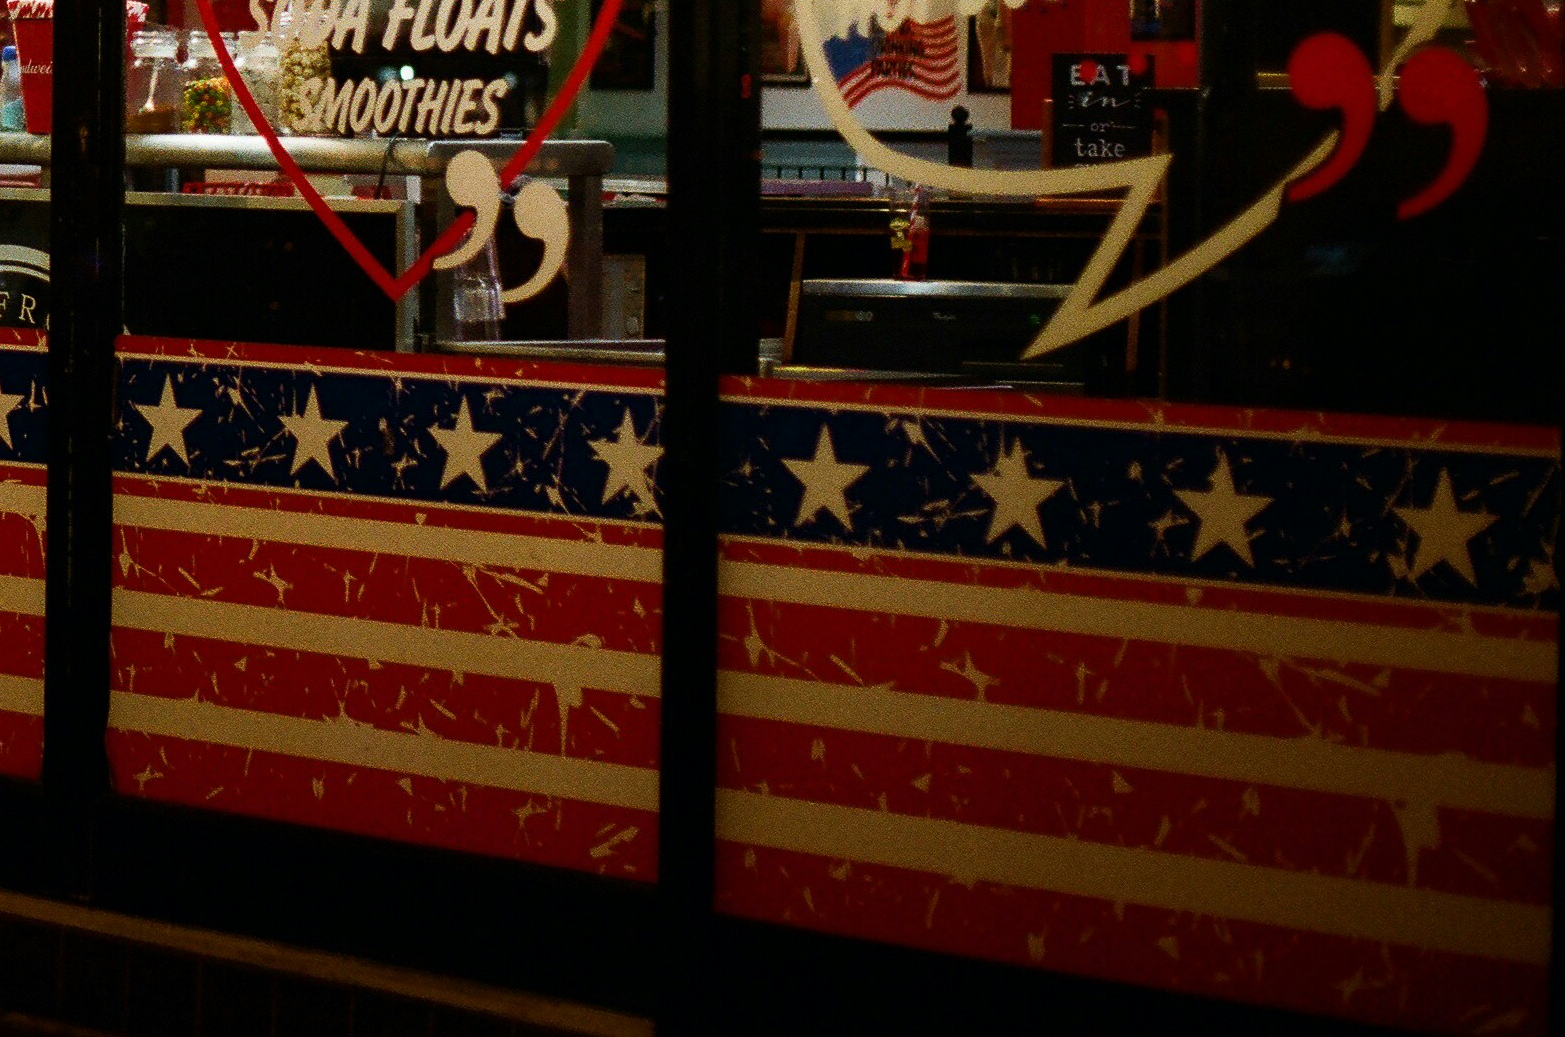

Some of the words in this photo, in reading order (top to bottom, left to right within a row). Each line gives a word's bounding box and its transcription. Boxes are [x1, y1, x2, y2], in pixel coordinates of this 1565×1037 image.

[1069, 64, 1130, 86] EAT
[291, 76, 511, 135] SMOOTHIES
[1075, 137, 1125, 159] take
